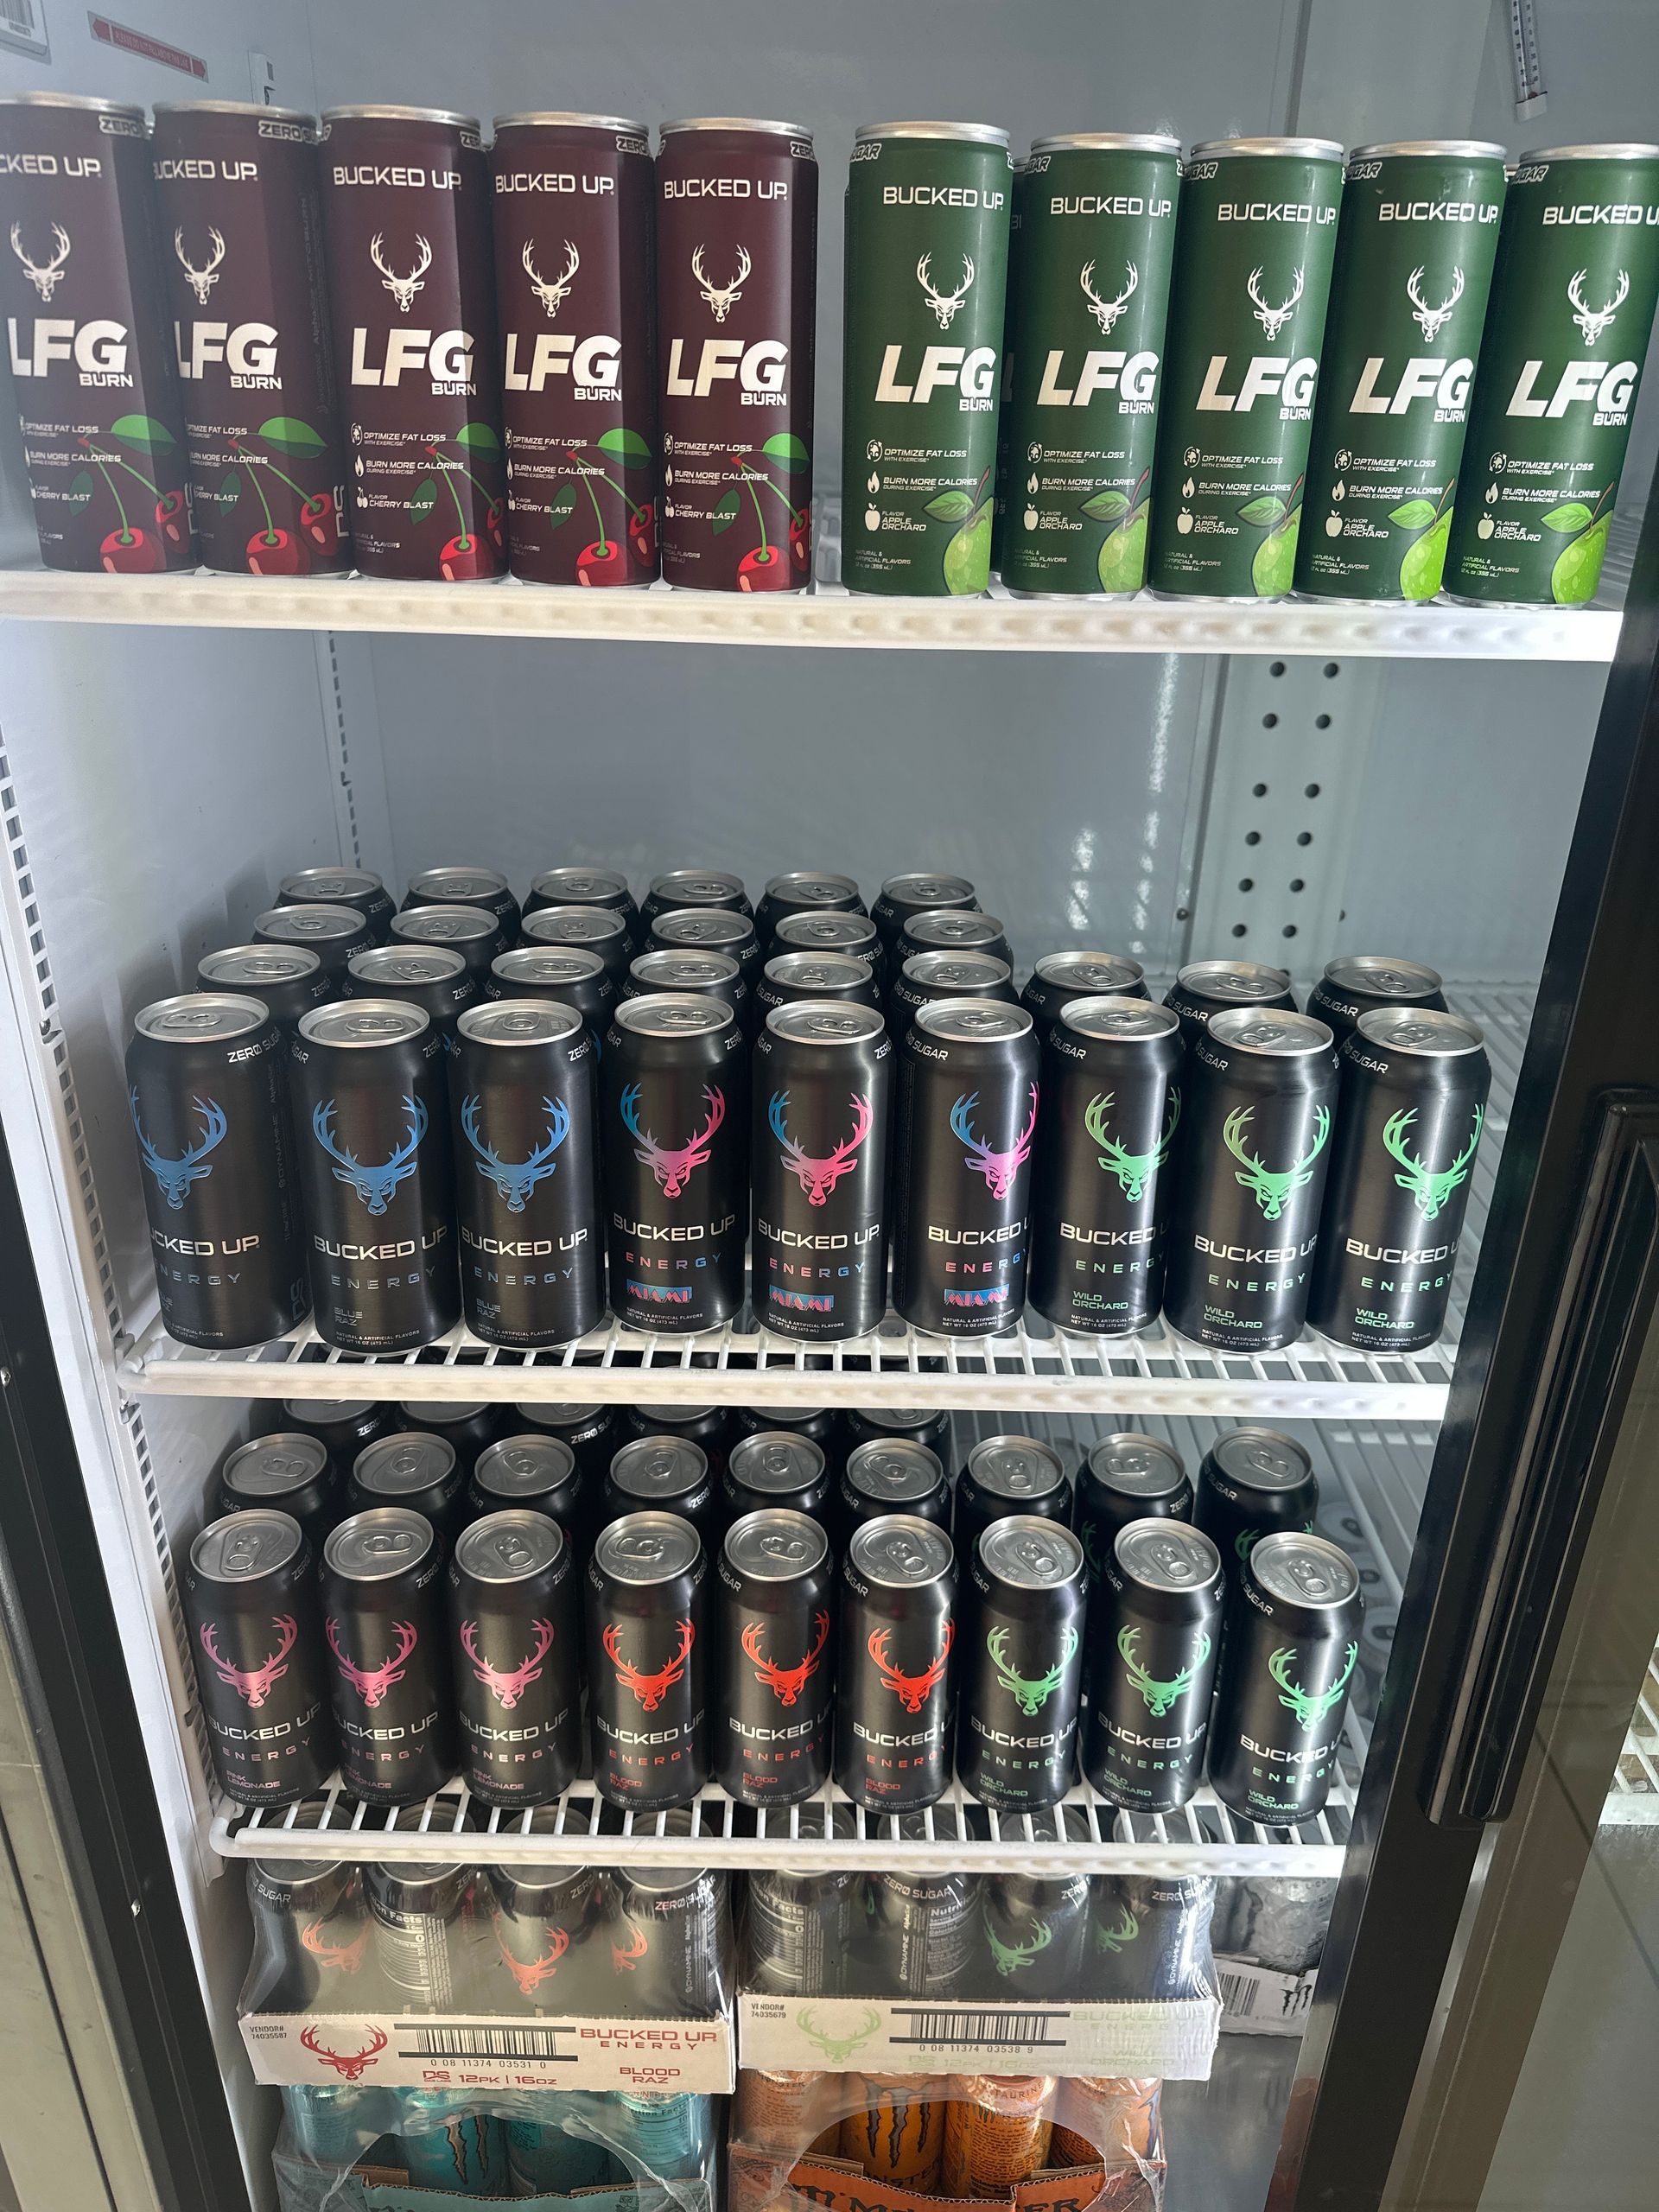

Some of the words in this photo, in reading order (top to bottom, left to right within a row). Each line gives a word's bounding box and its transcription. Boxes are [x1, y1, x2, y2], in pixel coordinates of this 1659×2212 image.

[63, 156, 101, 176] UP
[333, 167, 425, 186] BUCKED
[432, 169, 461, 189] UP
[496, 174, 575, 193] BUCKED
[582, 175, 614, 194] UP
[664, 179, 750, 199] BUCKED
[757, 180, 788, 200] UP
[883, 187, 978, 207] BUCKED
[983, 192, 1004, 210] UP
[1051, 197, 1143, 215] BUCKED
[1148, 199, 1172, 217] UP
[1217, 204, 1313, 223] BUCKED
[1316, 207, 1336, 225] UP
[1379, 202, 1476, 222] BUCKED
[1478, 205, 1498, 224] UP
[1542, 205, 1643, 225] BUCKED
[7, 317, 128, 378] LFG
[351, 327, 475, 387] LFG
[505, 334, 622, 391] LFG
[667, 339, 789, 397] LFG
[79, 372, 134, 388] BURN
[230, 373, 283, 390] BURN
[874, 345, 996, 404] LFG
[1037, 350, 1160, 407] LFG
[1196, 356, 1318, 412] LFG
[432, 383, 477, 396] BURN
[574, 387, 622, 401] BURN
[1349, 358, 1474, 415] LFG
[1505, 360, 1638, 418] LFG
[741, 391, 787, 406] BURN
[959, 397, 994, 411] BURN
[1118, 401, 1154, 415] BURN
[1279, 407, 1312, 421] BURN
[1433, 410, 1465, 423] BURN
[1592, 411, 1628, 426] BURN
[674, 442, 708, 451] OPTIMIZE
[1353, 458, 1395, 467] OPTIMIZE
[674, 470, 695, 479] BURN
[1529, 489, 1559, 498] MORE
[403, 501, 434, 510] BLAST
[516, 504, 543, 512] CHERRY
[676, 510, 704, 518] CHERRY
[706, 512, 736, 520] BLAST
[1173, 1001, 1208, 1021] SUGAR
[1320, 995, 1358, 1017] SUGAR
[227, 1043, 263, 1064] ZERO
[912, 1040, 949, 1061] SUGAR
[1053, 1038, 1087, 1059] SUGAR
[1350, 1050, 1389, 1074] SUGAR
[613, 1212, 704, 1242] BUCKED
[710, 1214, 735, 1236] UP
[759, 1218, 849, 1249] BUCKED
[854, 1224, 880, 1246] UP
[928, 1222, 1021, 1246] BUCKED
[1060, 1222, 1157, 1246] BUCKED
[221, 1235, 260, 1255] UP
[315, 1236, 415, 1260] BUCKED
[422, 1225, 448, 1251] UP
[461, 1225, 552, 1256] BUCKED
[559, 1228, 588, 1251] UP
[1194, 1234, 1296, 1264] BUCKED
[1346, 1237, 1448, 1264] BUCKED
[626, 1252, 721, 1270] ENERGY
[769, 1257, 864, 1278] ENERGY
[331, 1265, 435, 1290] ENERGY
[475, 1266, 573, 1286] ENERGY
[1208, 1272, 1306, 1292] ENERGY
[1360, 1270, 1452, 1293] ENERGY
[626, 1282, 691, 1303] MIAMI
[769, 1287, 835, 1312] MIAMI
[944, 1286, 1009, 1306] MIAMI
[1073, 1290, 1103, 1301] WILD
[334, 1306, 363, 1319] BLUE
[476, 1298, 501, 1312] BLUE
[1072, 1299, 1128, 1310] ORCHARD
[1205, 1305, 1235, 1319] WILD
[1356, 1307, 1388, 1320] WILD
[334, 1316, 358, 1326] RAZ
[1204, 1313, 1262, 1329] ORCHARD
[1355, 1315, 1415, 1329] ORCHARD
[207, 1714, 290, 1740] BUCKED
[460, 1711, 539, 1742] BUCKED
[596, 1716, 679, 1745] BUCKED
[729, 1716, 814, 1740] BUCKED
[854, 1721, 937, 1747] BUCKED
[971, 1715, 1054, 1749] BUCKED
[1098, 1711, 1181, 1749] BUCKED
[222, 1737, 311, 1761] ENERGY
[471, 1742, 556, 1763] ENERGY
[609, 1744, 694, 1766] ENERGY
[1107, 1745, 1193, 1770] ENERGY
[1241, 1734, 1328, 1764] BUCKED
[982, 1750, 1066, 1770] ENERGY
[610, 1772, 643, 1787] BLOOD
[1253, 1759, 1333, 1783] ENERGY
[228, 1777, 280, 1789] LEMONADE
[980, 1779, 1029, 1797] ORCHARD
[1103, 1775, 1152, 1797] ORCHARD
[1248, 1789, 1275, 1802] WILD
[1248, 1796, 1300, 1810] ORCHARD
[883, 1873, 911, 1896] ZERO
[581, 2029, 679, 2041] BUCKED
[684, 2031, 716, 2042] UP
[600, 2041, 698, 2050] ENERGY
[950, 2044, 980, 2053] 11374
[987, 2044, 1021, 2053] 03538
[499, 2060, 531, 2069] 03531
[619, 2067, 681, 2075] BLOOD
[632, 2075, 669, 2084] RAZ
